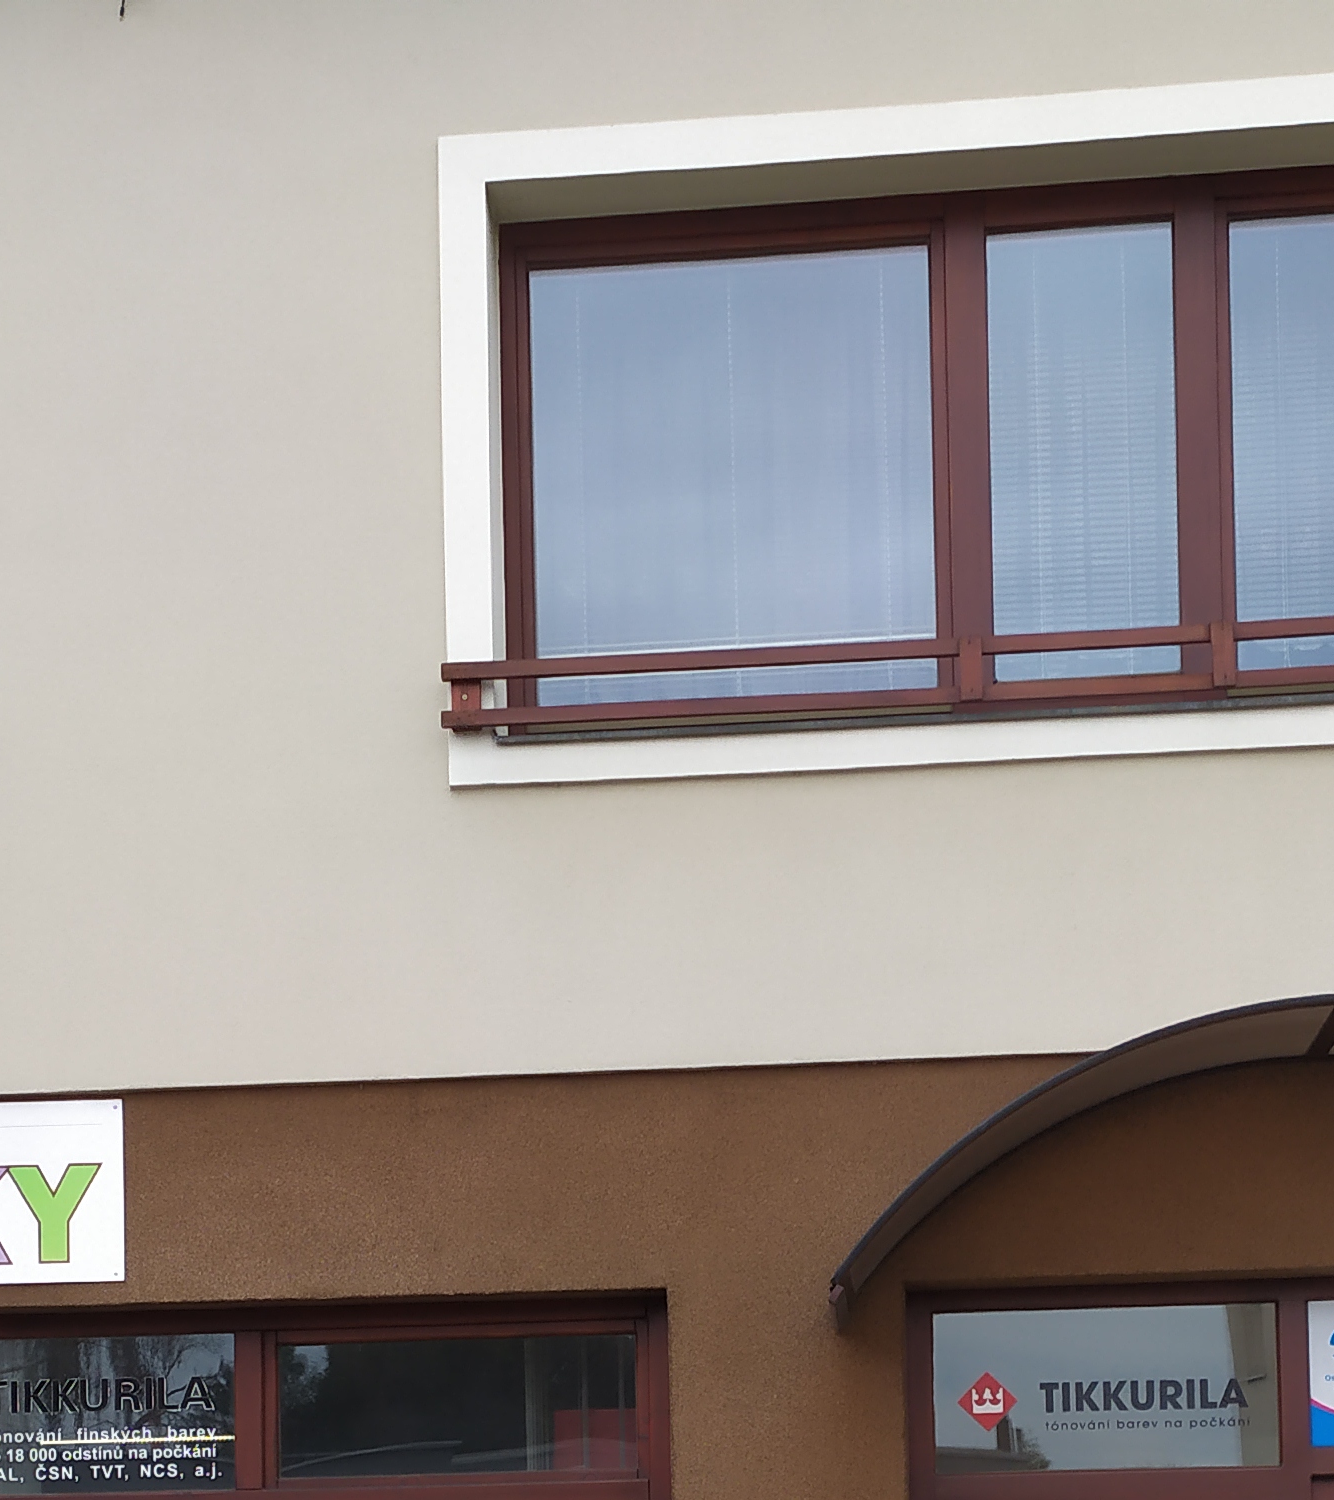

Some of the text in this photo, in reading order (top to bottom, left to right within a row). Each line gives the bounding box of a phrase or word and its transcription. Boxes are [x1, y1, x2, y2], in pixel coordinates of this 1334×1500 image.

[1039, 1378, 1248, 1413] TIKKURILA
[1045, 1416, 1251, 1431] tónování barev na počkání
[77, 1426, 152, 1444] finských
[168, 1426, 216, 1440] barev
[7, 1449, 24, 1462] 18
[30, 1448, 56, 1461] 000
[62, 1445, 122, 1461] odstínů
[128, 1449, 147, 1460] na
[153, 1444, 217, 1462] počkání
[36, 1463, 79, 1482] ČSN,
[90, 1465, 128, 1480] TVT,
[140, 1464, 183, 1479] NCS,
[194, 1463, 222, 1478] a.j.
